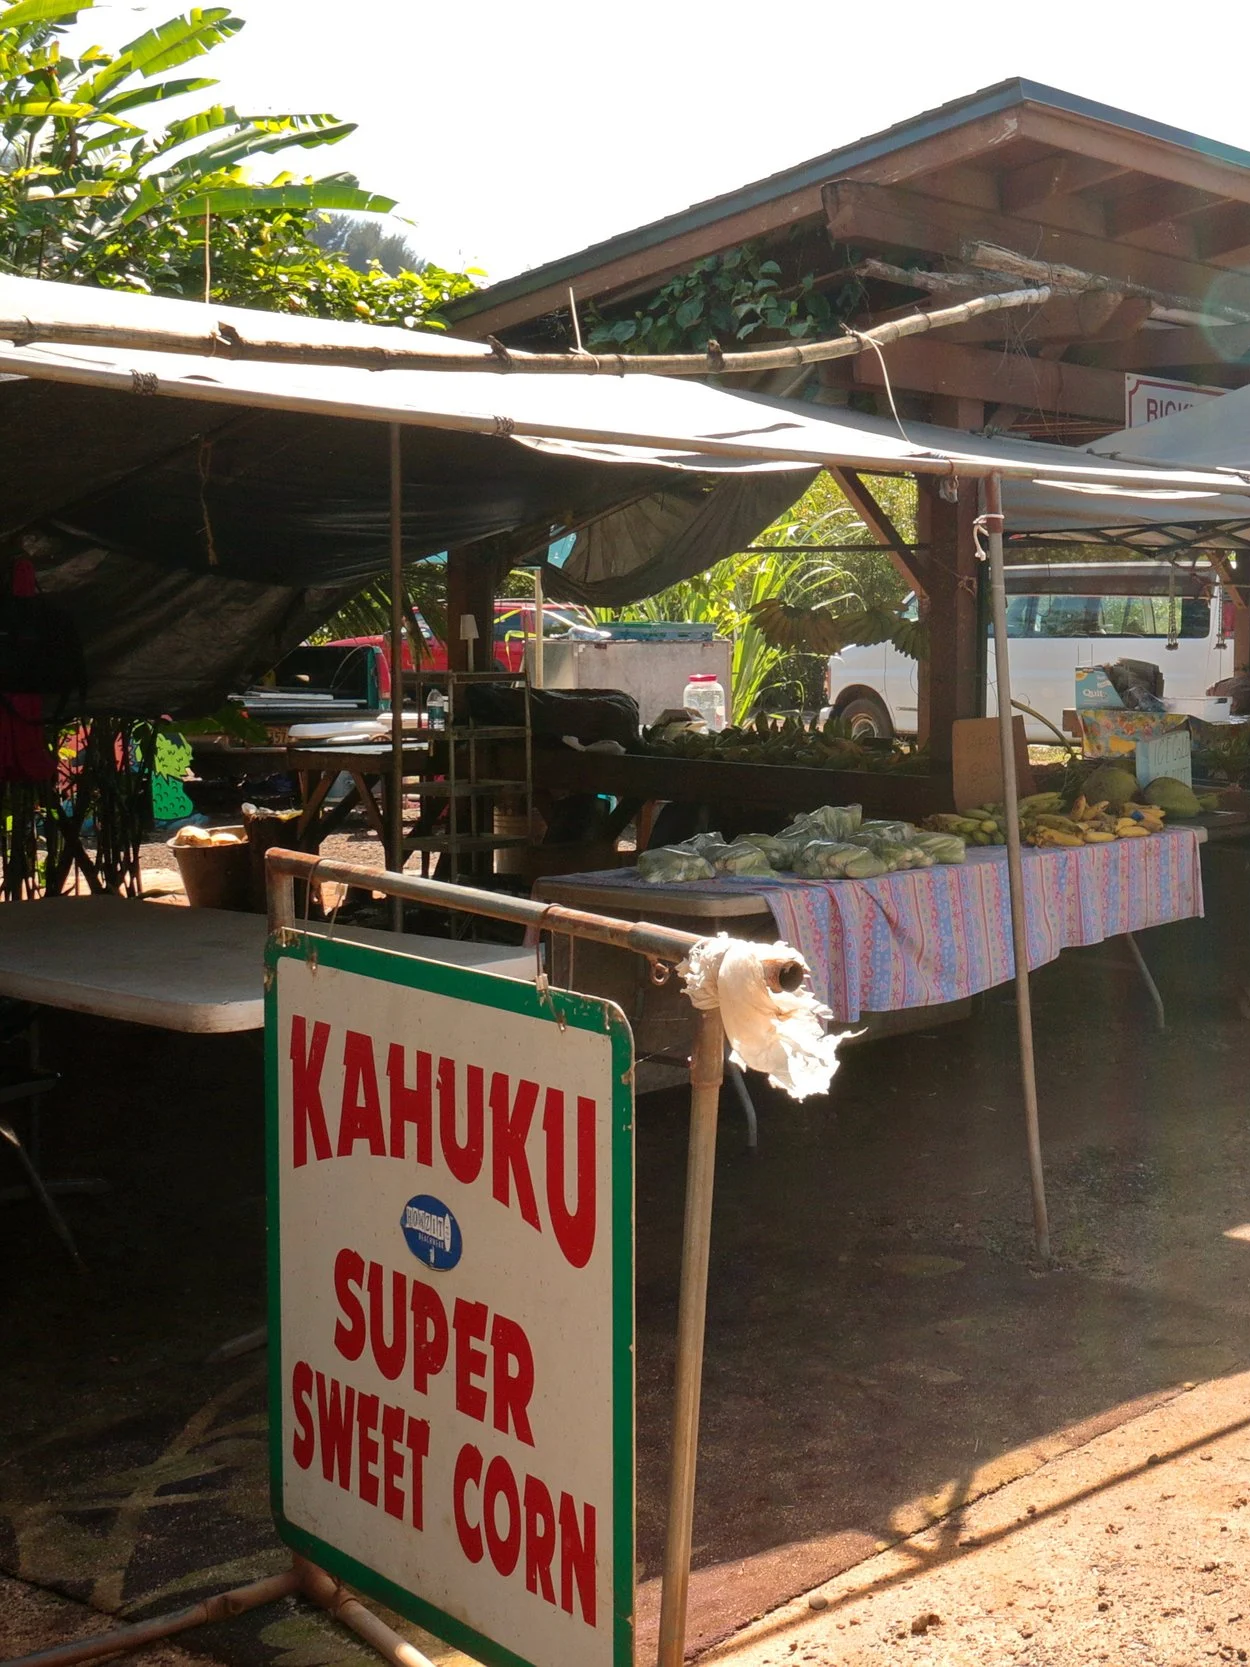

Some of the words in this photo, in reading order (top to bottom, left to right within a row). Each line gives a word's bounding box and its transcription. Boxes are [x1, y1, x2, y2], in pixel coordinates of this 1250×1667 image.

[291, 1015, 597, 1269] KAHUKU
[405, 1206, 444, 1241] HOWZIT
[334, 1248, 535, 1448] SUPER
[292, 1361, 430, 1532] SWEET
[453, 1443, 598, 1629] CORN
